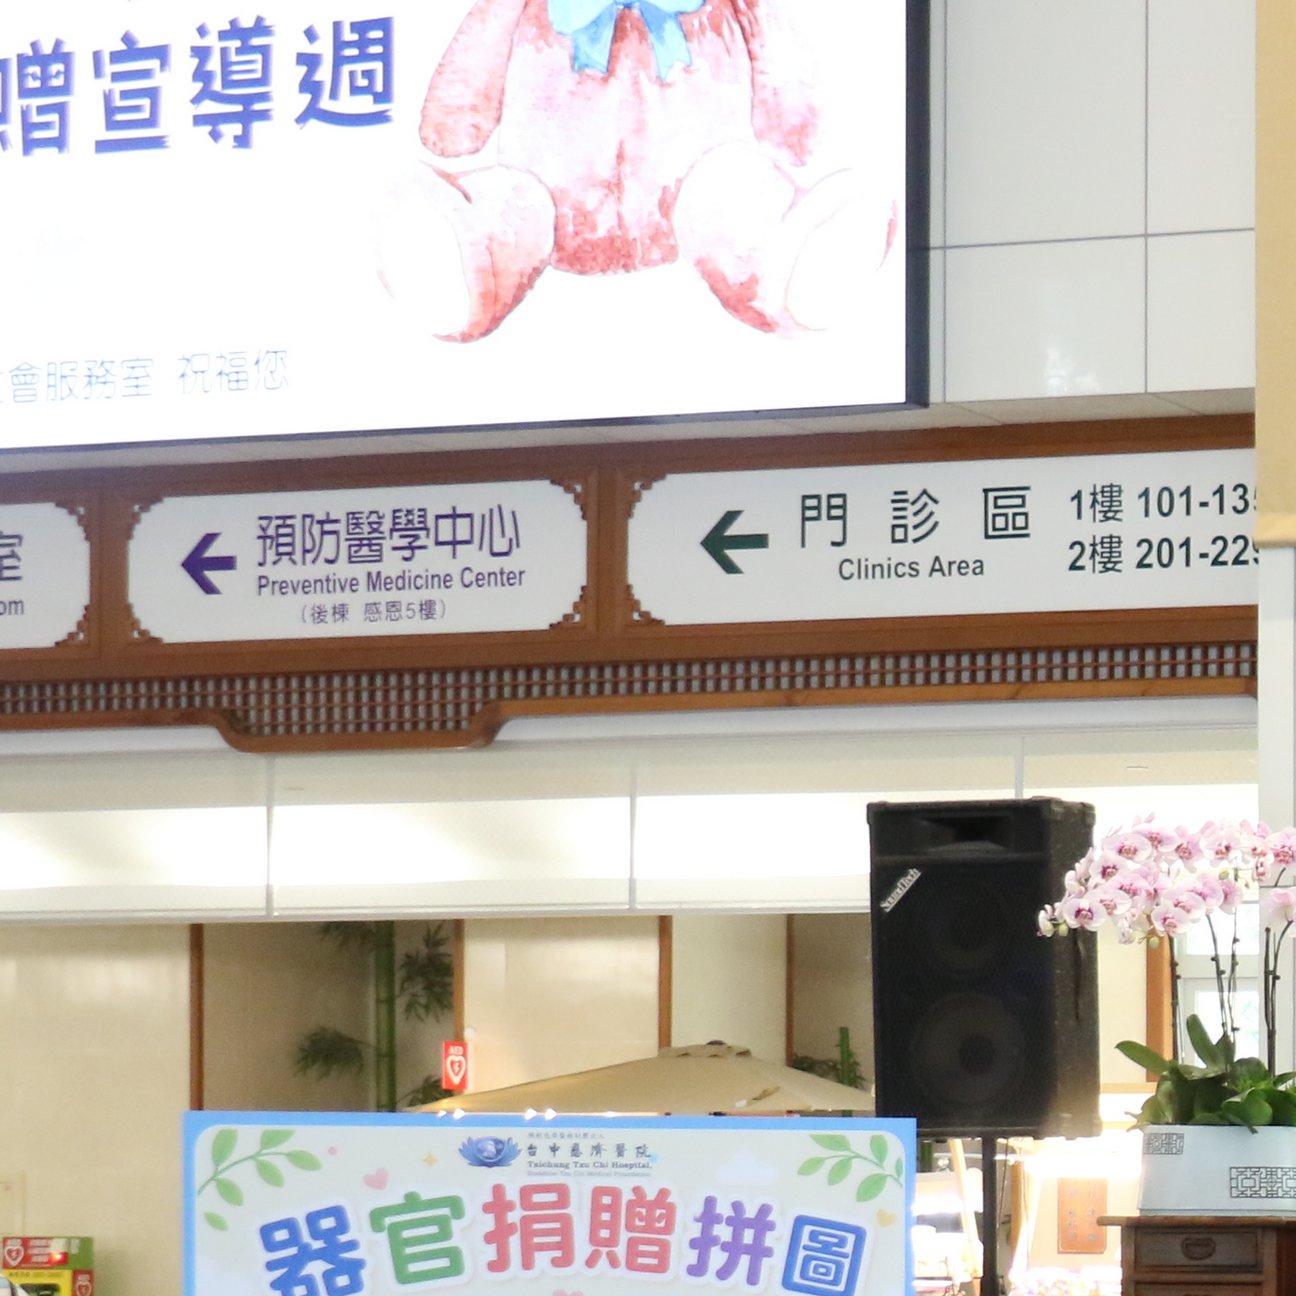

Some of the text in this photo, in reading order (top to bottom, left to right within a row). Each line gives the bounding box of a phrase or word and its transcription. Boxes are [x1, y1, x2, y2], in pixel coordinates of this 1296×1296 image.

[0, 349, 289, 403] 會服務室 祝福您
[799, 485, 1032, 549] 門診區
[1069, 482, 1258, 525] 1樓 101-13
[256, 503, 521, 568] 預防醫學中心
[1067, 532, 1125, 575] 2樓
[257, 565, 526, 597] Preventive Medicine Center
[838, 556, 985, 582] Clinics Area
